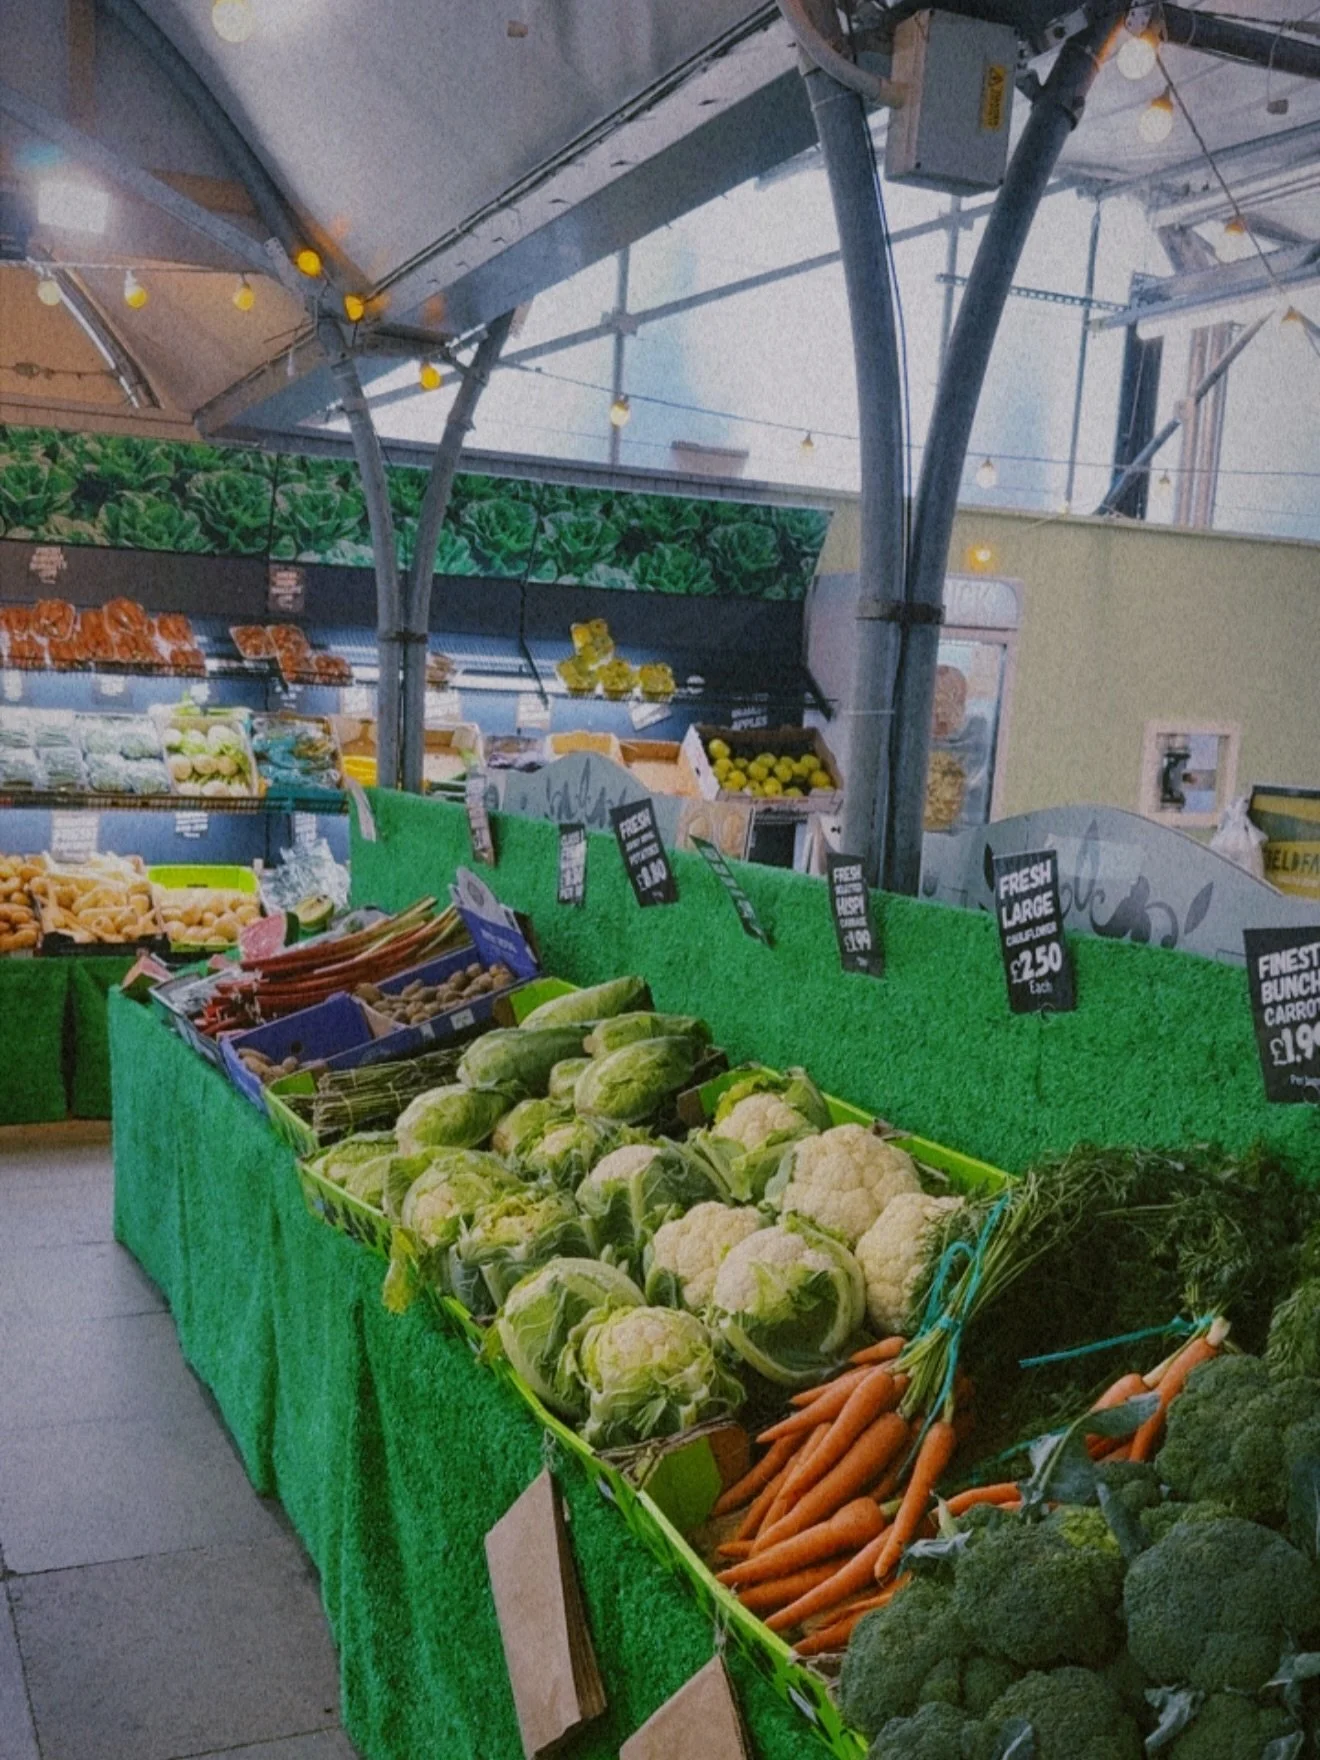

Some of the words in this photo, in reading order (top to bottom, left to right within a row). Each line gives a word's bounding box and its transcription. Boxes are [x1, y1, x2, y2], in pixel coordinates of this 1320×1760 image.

[619, 808, 652, 840] FRESH
[833, 864, 862, 885] FRESH
[1000, 859, 1052, 899] FRESH
[1001, 890, 1055, 930] LARGE
[1006, 921, 1058, 947] CAULIFLOWER
[1010, 942, 1063, 984] £2.50
[1258, 941, 1320, 981] FINEST
[1029, 979, 1053, 995] Each
[1261, 968, 1320, 1005] BUNCH
